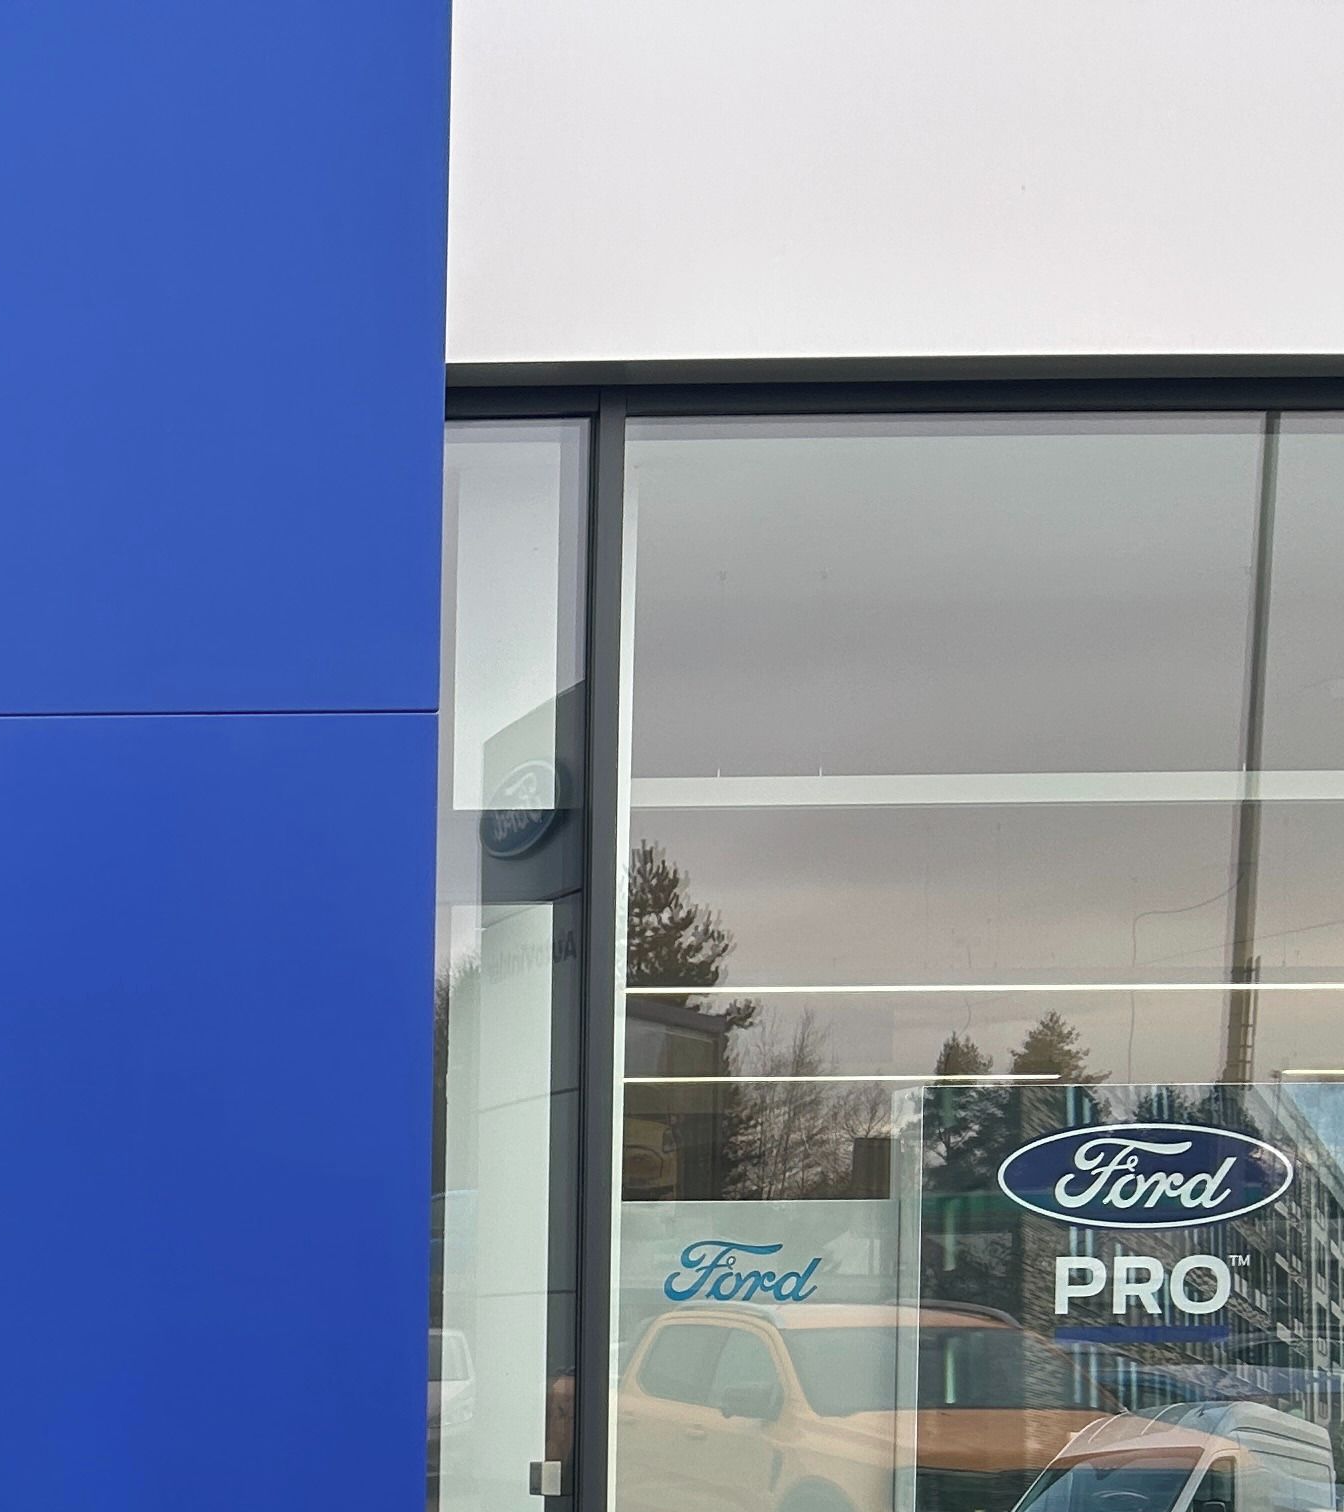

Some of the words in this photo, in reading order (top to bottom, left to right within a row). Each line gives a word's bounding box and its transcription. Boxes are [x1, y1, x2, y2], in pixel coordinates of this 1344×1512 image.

[1054, 1137, 1239, 1209] Ford
[664, 1240, 823, 1301] Ford
[1054, 1255, 1230, 1315] PRO
